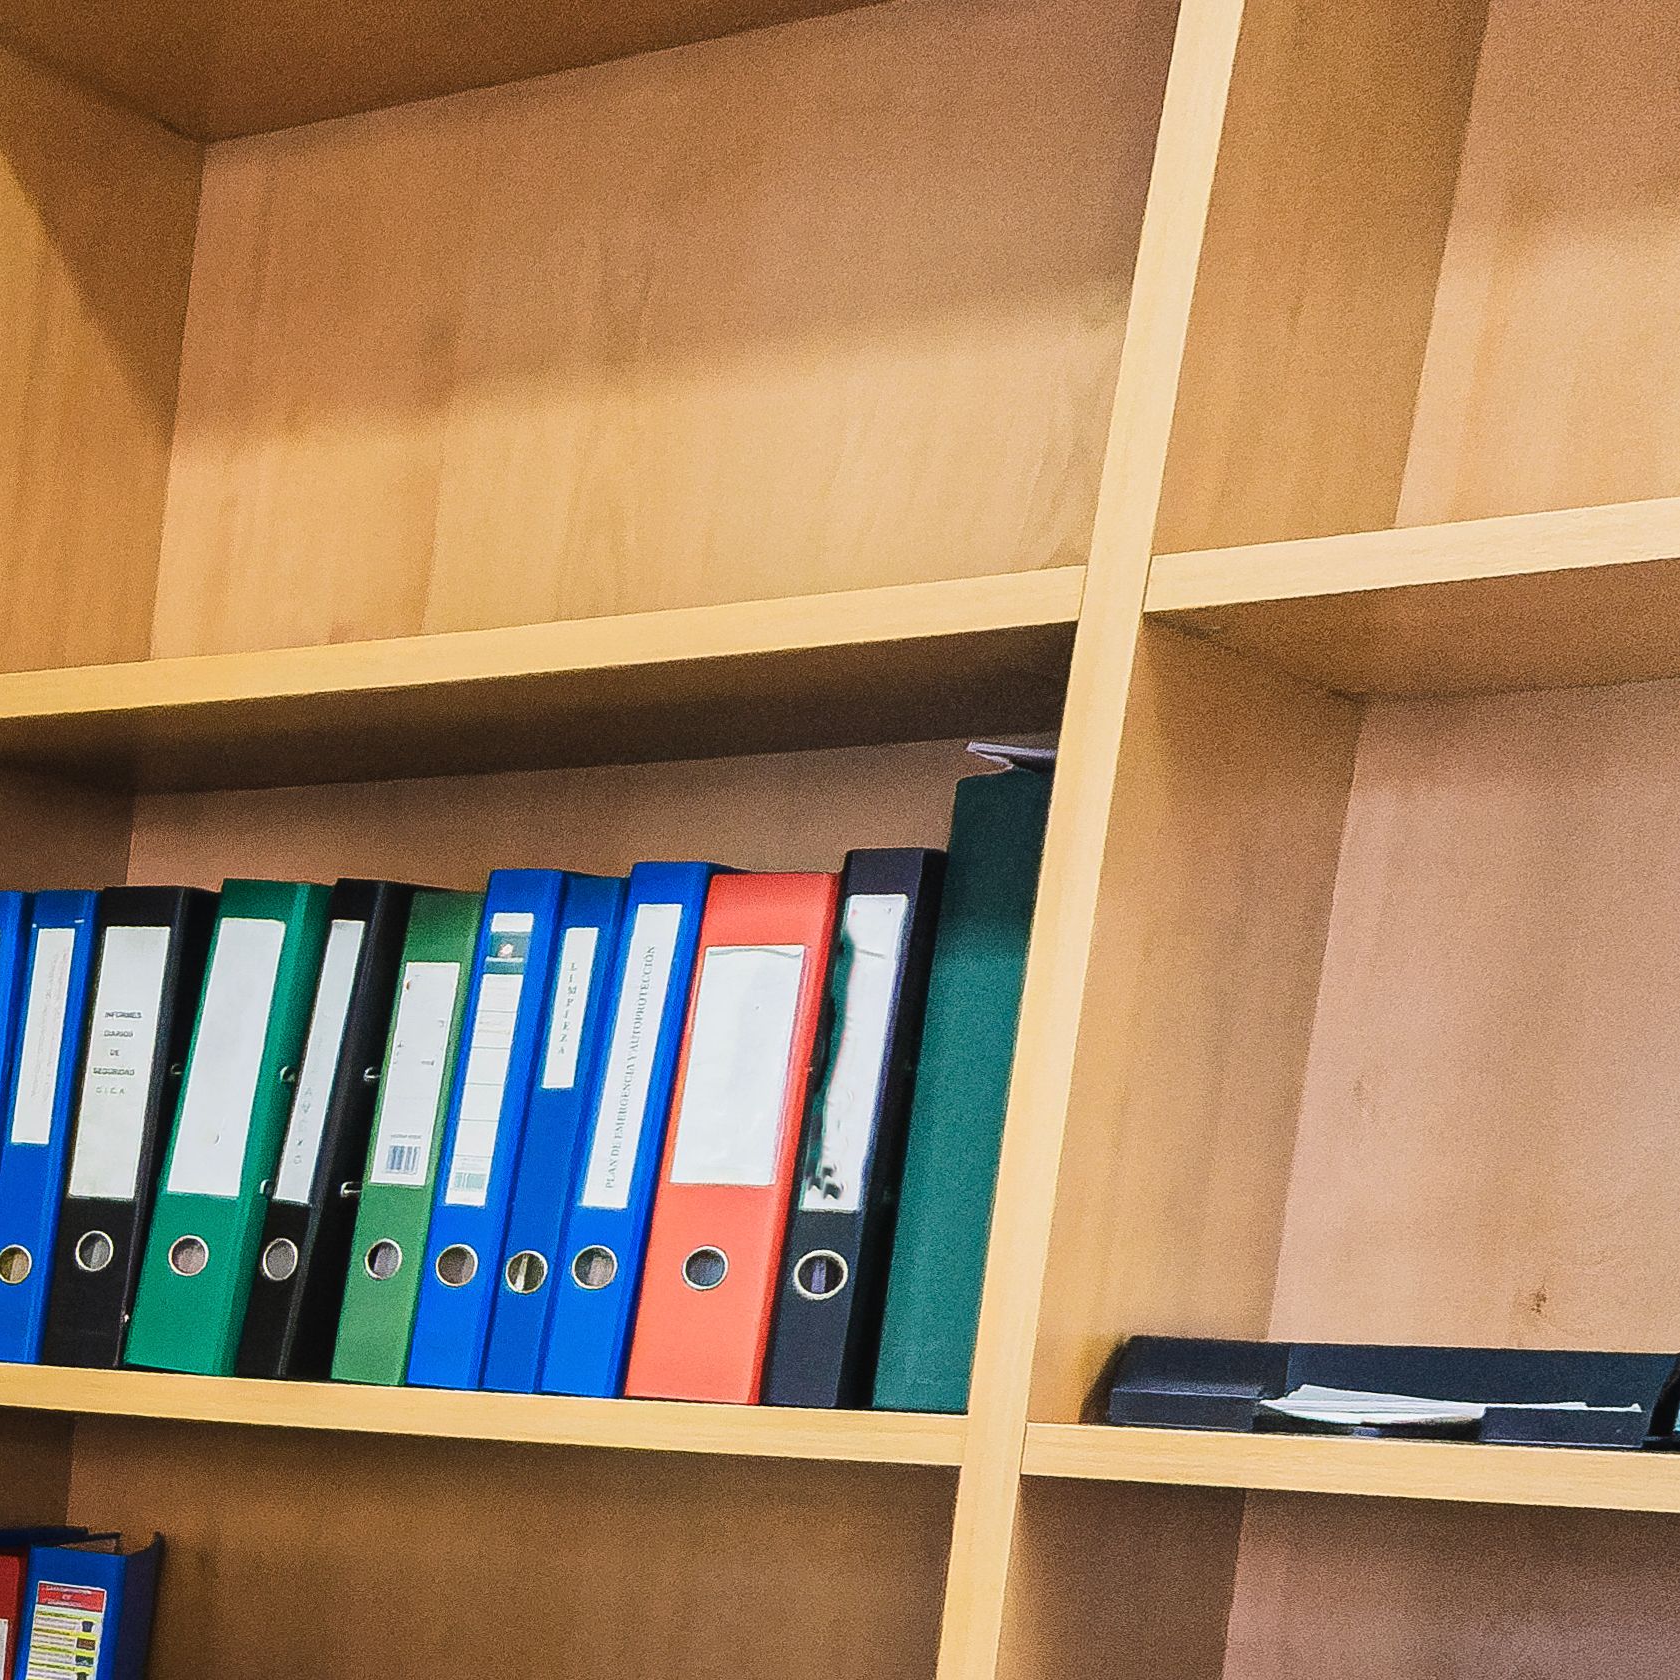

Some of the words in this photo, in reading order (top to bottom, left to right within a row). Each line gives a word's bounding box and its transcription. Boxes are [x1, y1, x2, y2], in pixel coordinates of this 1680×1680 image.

[629, 946, 656, 1051] AUTOPROTECCIÓN
[614, 1064, 635, 1139] EMERGENCIA
[605, 1159, 617, 1188] PLAN
[610, 1143, 621, 1156] DE
